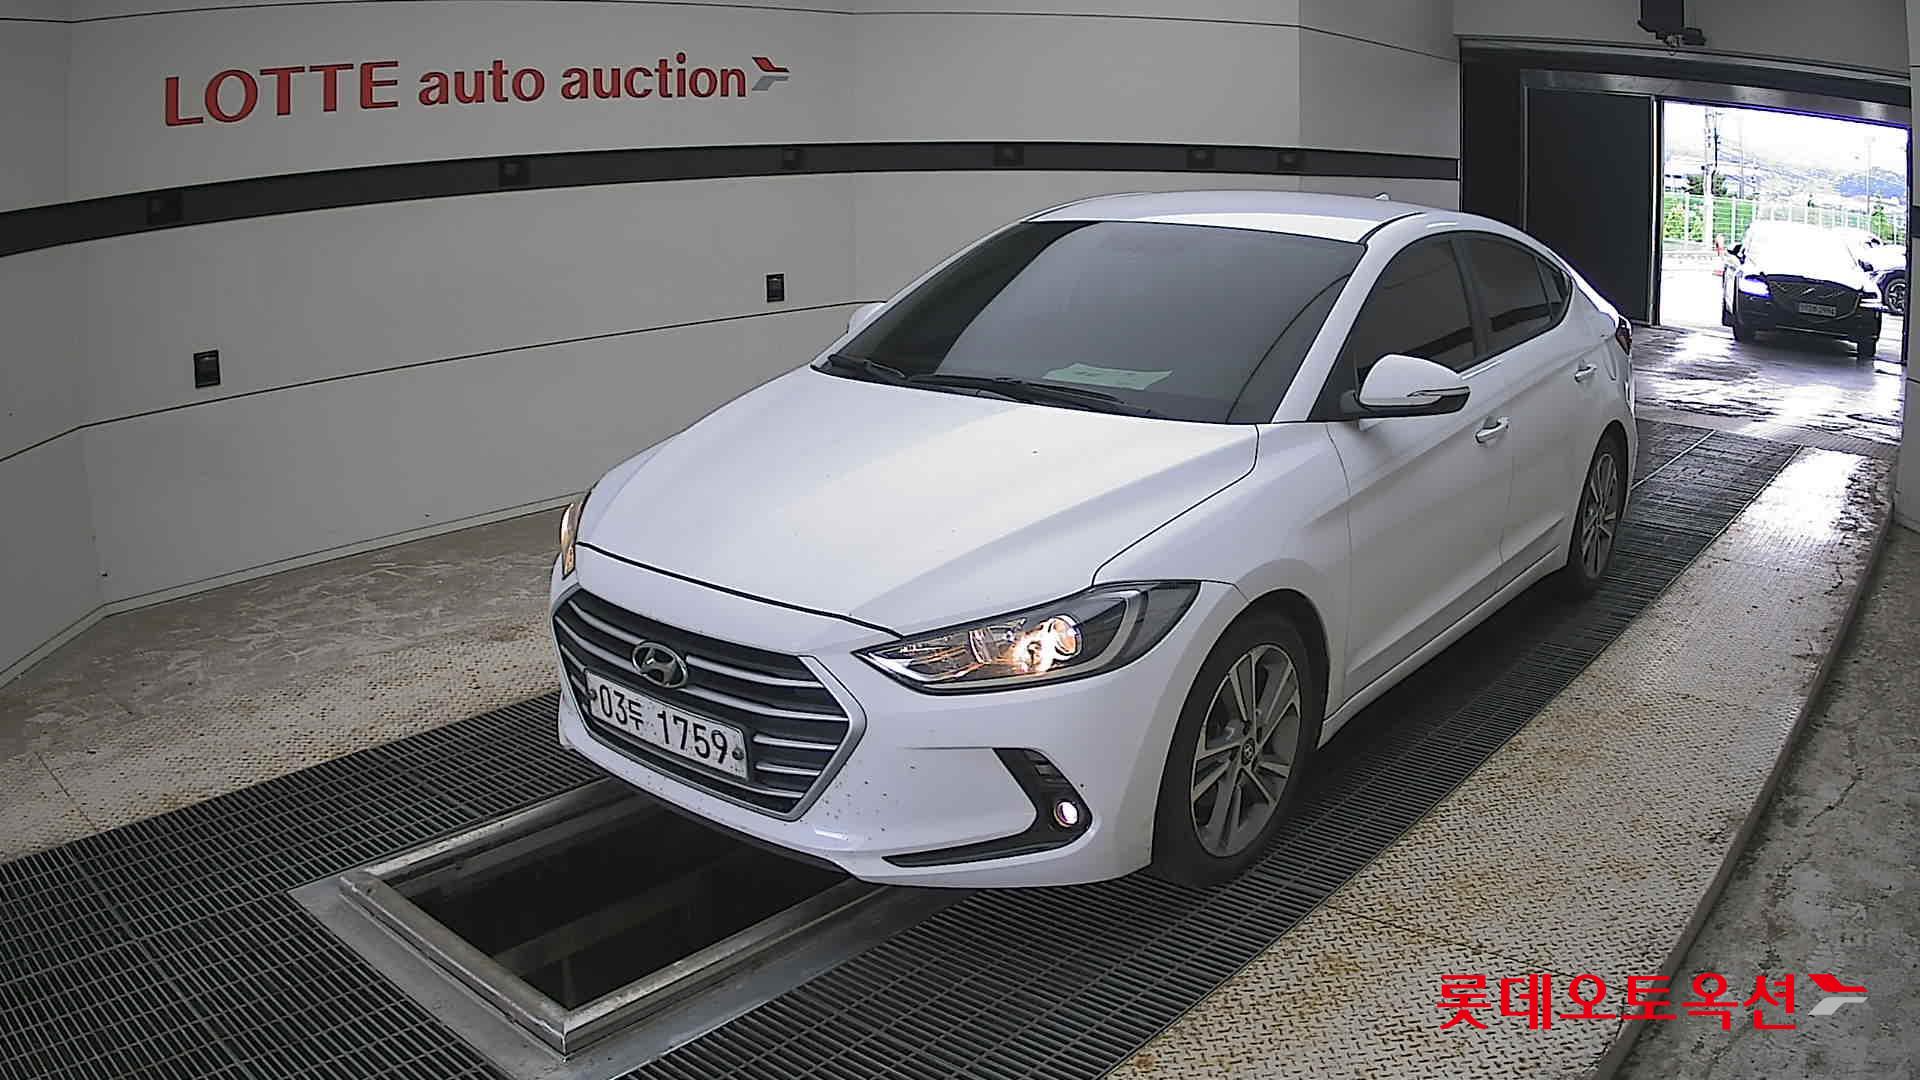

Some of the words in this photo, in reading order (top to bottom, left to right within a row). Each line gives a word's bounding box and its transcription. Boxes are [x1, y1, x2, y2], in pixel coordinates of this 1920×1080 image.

[165, 60, 399, 127] LOTTE
[418, 59, 546, 106] auto
[560, 52, 748, 99] auction
[599, 684, 644, 731] 03두
[657, 710, 728, 764] 1759
